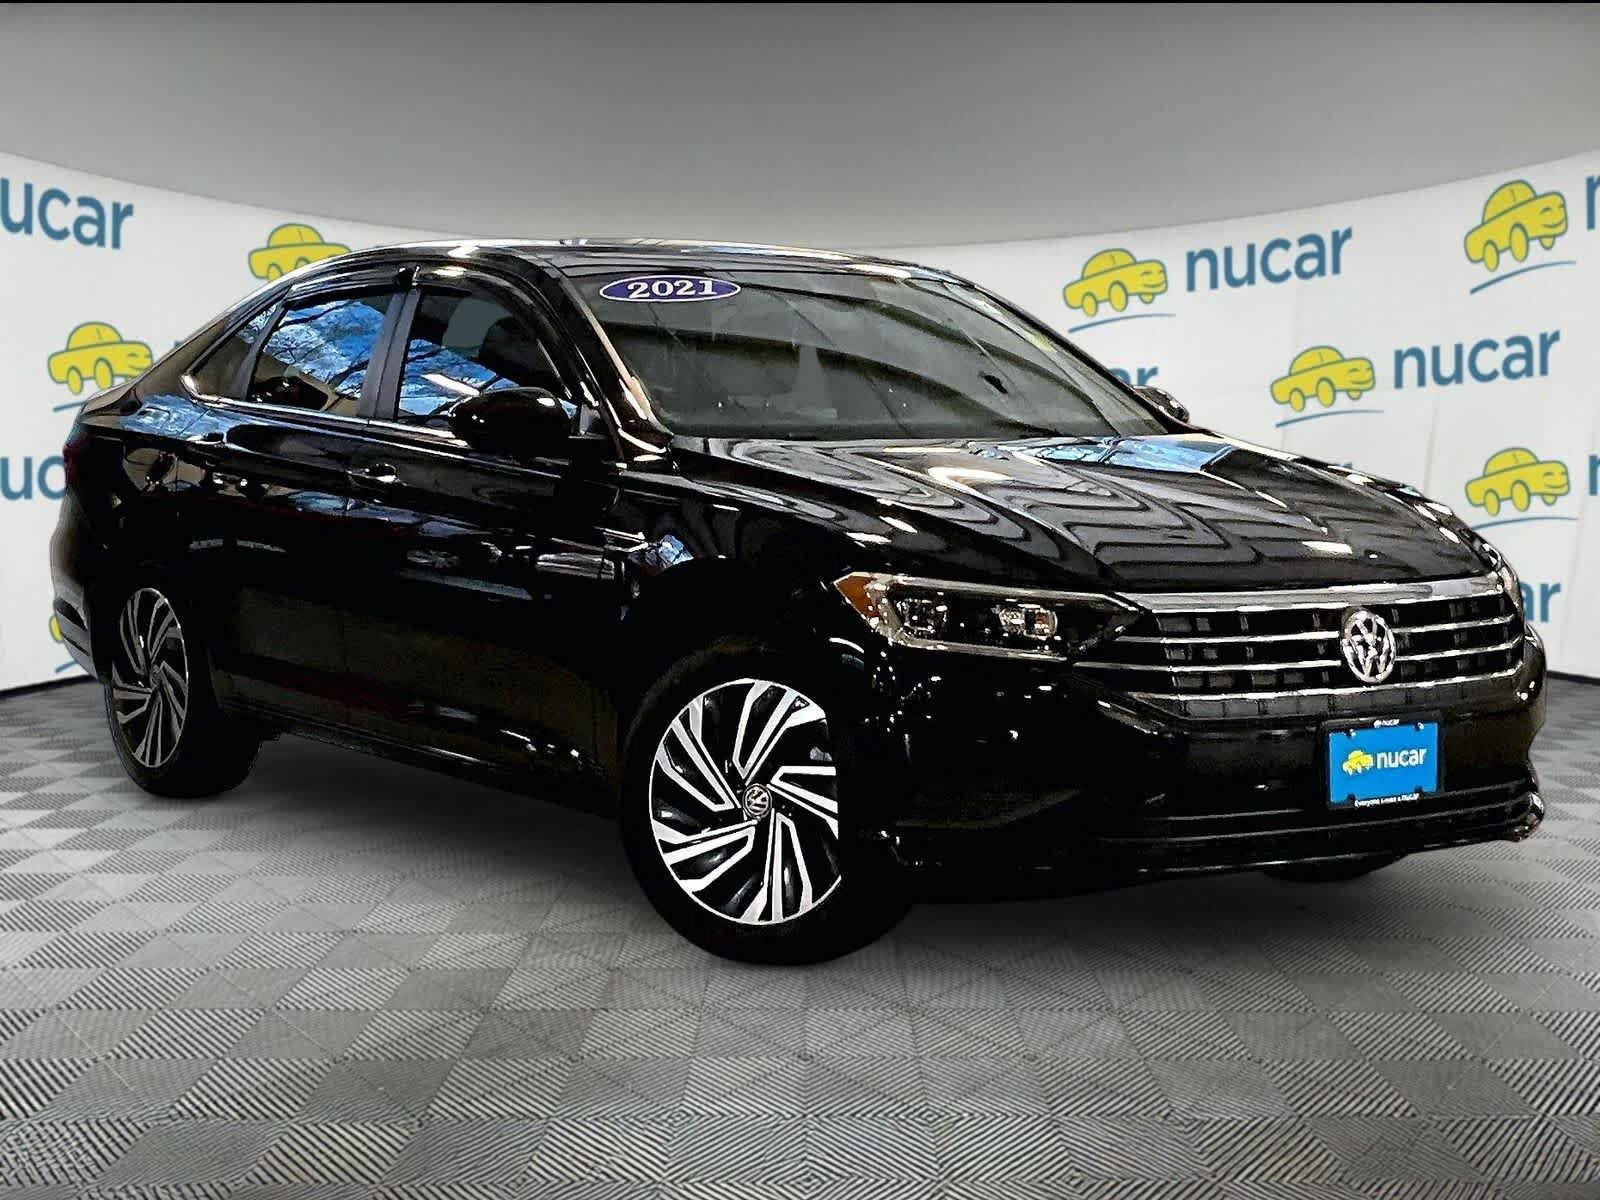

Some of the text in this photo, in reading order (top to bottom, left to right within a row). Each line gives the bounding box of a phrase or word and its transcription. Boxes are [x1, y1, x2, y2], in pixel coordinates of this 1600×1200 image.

[1185, 227, 1352, 293] nucar
[627, 279, 717, 299] 2021
[1393, 330, 1561, 389] nucar
[1376, 748, 1427, 770] nucar
